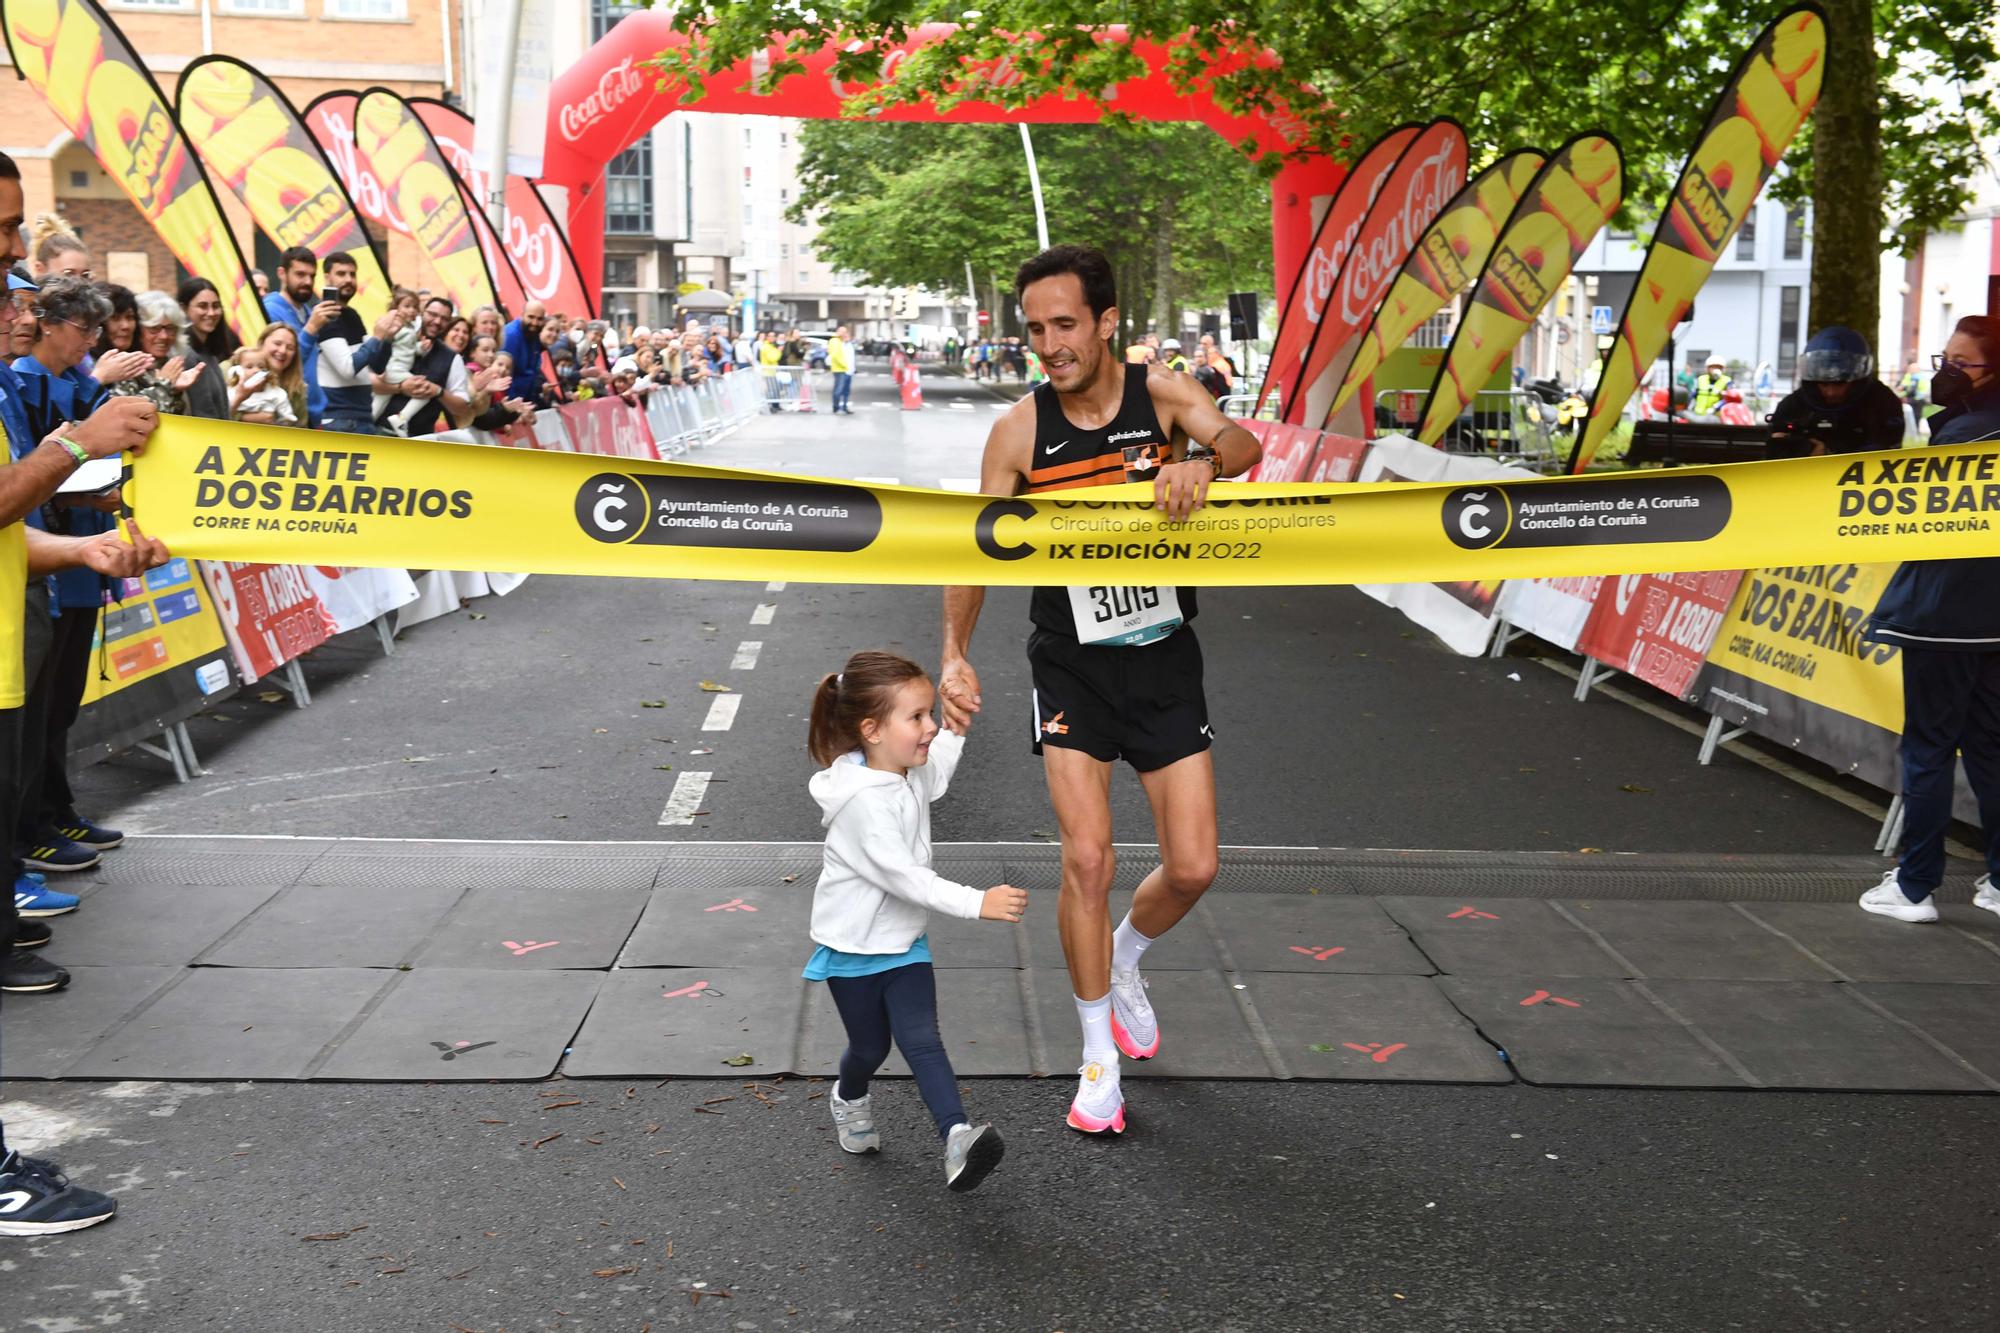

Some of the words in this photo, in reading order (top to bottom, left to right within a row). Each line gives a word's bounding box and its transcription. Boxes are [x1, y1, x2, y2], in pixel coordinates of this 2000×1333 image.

[193, 446, 225, 475] A
[234, 447, 370, 481] XENTE
[1837, 461, 1864, 486] A
[1872, 453, 1999, 484] XENTE
[195, 479, 283, 510] DOS
[291, 483, 473, 519] BARRIOS
[658, 499, 760, 515] Ayuntamiento
[762, 503, 780, 515] de
[783, 504, 795, 516] A
[798, 504, 849, 518] Coruña
[1520, 500, 1614, 516] Ayuntamiento
[1617, 498, 1634, 510] de
[1637, 498, 1649, 509] A
[1651, 496, 1700, 509] Coruña
[1839, 487, 1918, 517] DOS
[193, 516, 250, 530] CORRE
[256, 518, 281, 531] NA
[285, 518, 358, 534] CORUÑA
[658, 515, 718, 528] Concello
[721, 517, 740, 529] da
[742, 518, 793, 532] Coruña
[1050, 516, 1123, 532] Circuíto
[1129, 518, 1152, 532] de
[1157, 516, 1240, 532] carreiras
[1244, 513, 1336, 534] populares
[1520, 516, 1575, 530] Concello
[1578, 515, 1595, 527] da
[1598, 513, 1647, 526] Coruña
[1838, 523, 1890, 537] CORRE
[1896, 522, 1918, 535] NA
[1922, 516, 1990, 533] CORUÑA
[1049, 543, 1075, 559] IX
[1082, 538, 1191, 559] EDICIÓN
[1197, 542, 1262, 559] 2022
[1740, 579, 1796, 632] DOS
[1752, 642, 1774, 666] NA
